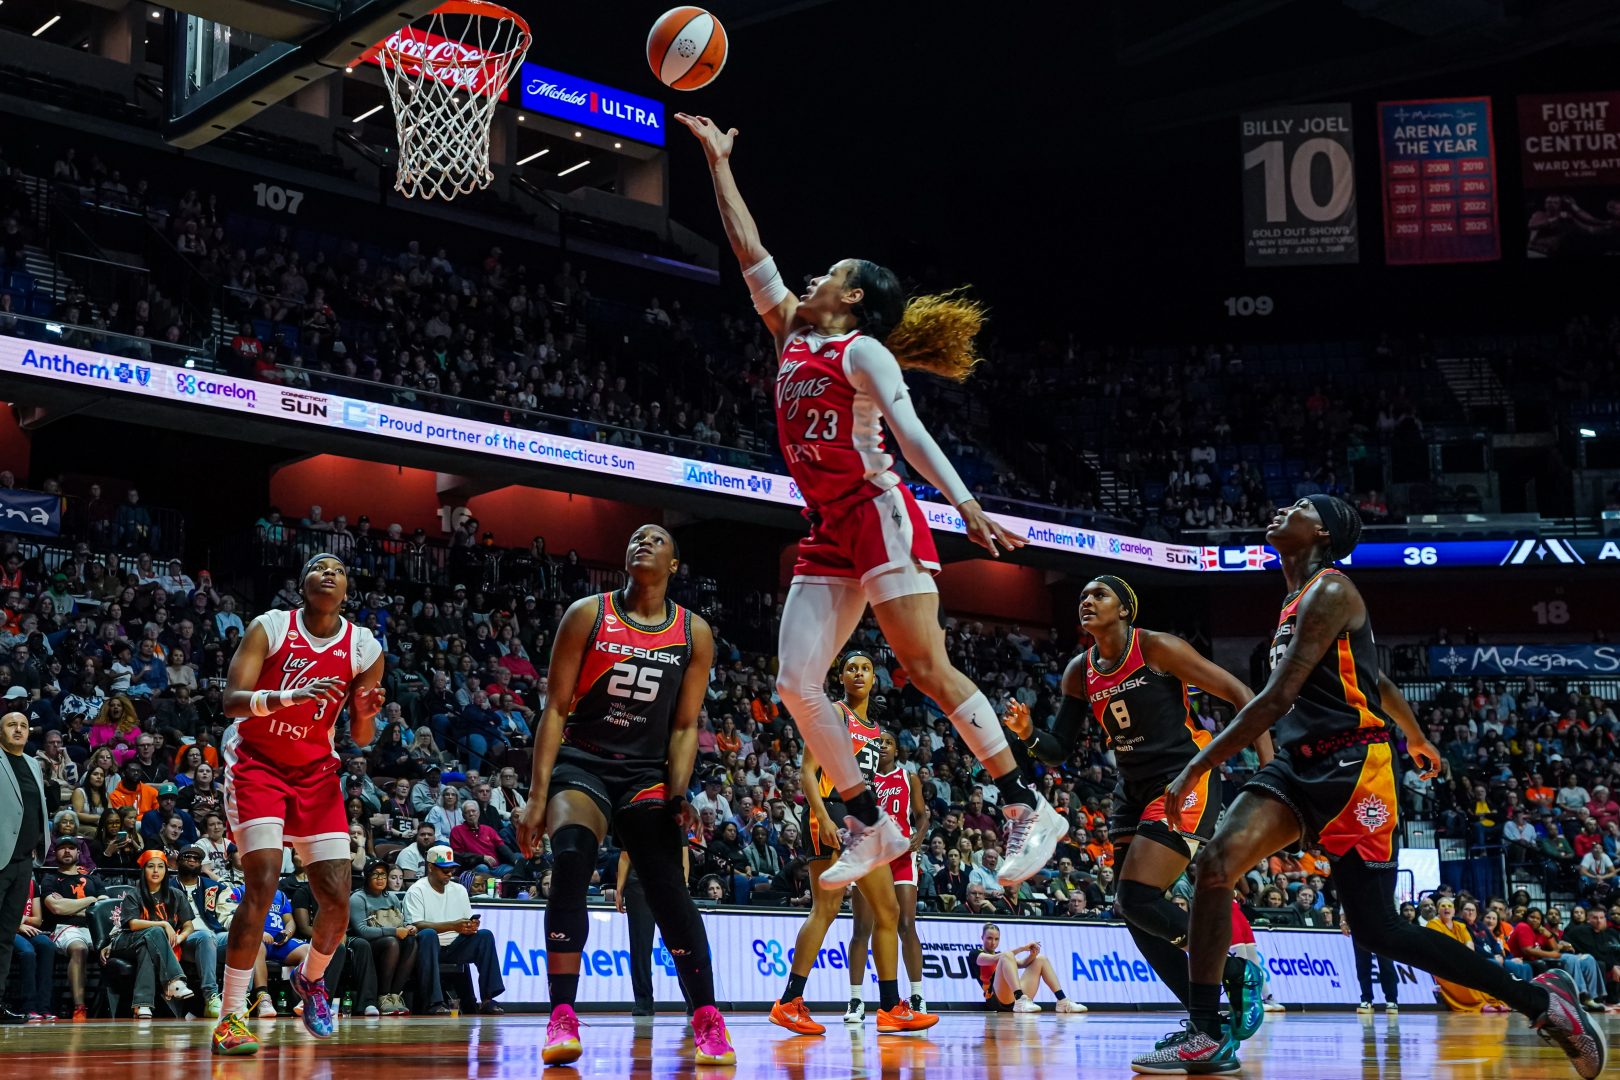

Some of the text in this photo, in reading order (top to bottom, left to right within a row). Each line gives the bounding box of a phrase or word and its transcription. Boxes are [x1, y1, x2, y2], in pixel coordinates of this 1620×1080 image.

[527, 79, 659, 128] Michelob ULTRA
[1541, 101, 1610, 121] FIGHT
[1243, 117, 1349, 136] BILLY JOEL
[1393, 122, 1477, 139] ARENA OF
[1548, 119, 1605, 134] OF THE
[1396, 139, 1478, 155] THE YEAR
[1462, 161, 1484, 171] 2010
[1533, 159, 1569, 172] WARD
[1243, 137, 1353, 223] 10
[1464, 181, 1486, 191] 2016
[253, 182, 304, 215] 107
[1464, 201, 1486, 211] 2022
[1396, 204, 1416, 214] 2017
[1252, 225, 1350, 239] SOLD OUT SHOWS
[1256, 239, 1276, 247] NEW
[1278, 237, 1318, 245] ENGLAND
[1223, 295, 1274, 317] 109
[22, 348, 110, 381] Anthem
[824, 350, 840, 360] ally
[198, 379, 256, 400] carelon
[281, 390, 327, 402] CONNECTICUT
[777, 361, 832, 420] Vegas
[281, 398, 327, 418] SUN
[804, 408, 838, 440] 23
[380, 414, 634, 470] Proud partner of the Connecticut Sun
[786, 444, 822, 464] IPSY
[687, 466, 745, 489] Anthem
[928, 510, 953, 525] Let's
[1027, 526, 1073, 546] Anthem
[1120, 543, 1153, 556] carelon
[1166, 552, 1197, 565] SUN
[1403, 546, 1438, 565] 36
[1531, 600, 1570, 625] 18
[282, 652, 309, 672] Las
[333, 649, 347, 659] ally
[595, 640, 681, 666] KEESUSK
[1471, 645, 1589, 674] Mohegan
[607, 662, 663, 702] 25
[1090, 676, 1148, 703] KEESUSK
[314, 698, 328, 720] 3
[1110, 699, 1131, 730] 8
[269, 718, 315, 740] IPSY
[876, 781, 902, 806] Vegas
[893, 799, 900, 813] 0
[400, 820, 412, 831] 25
[269, 912, 283, 930] 32
[1268, 952, 1337, 977] carelon
[1331, 979, 1341, 988] Rx
